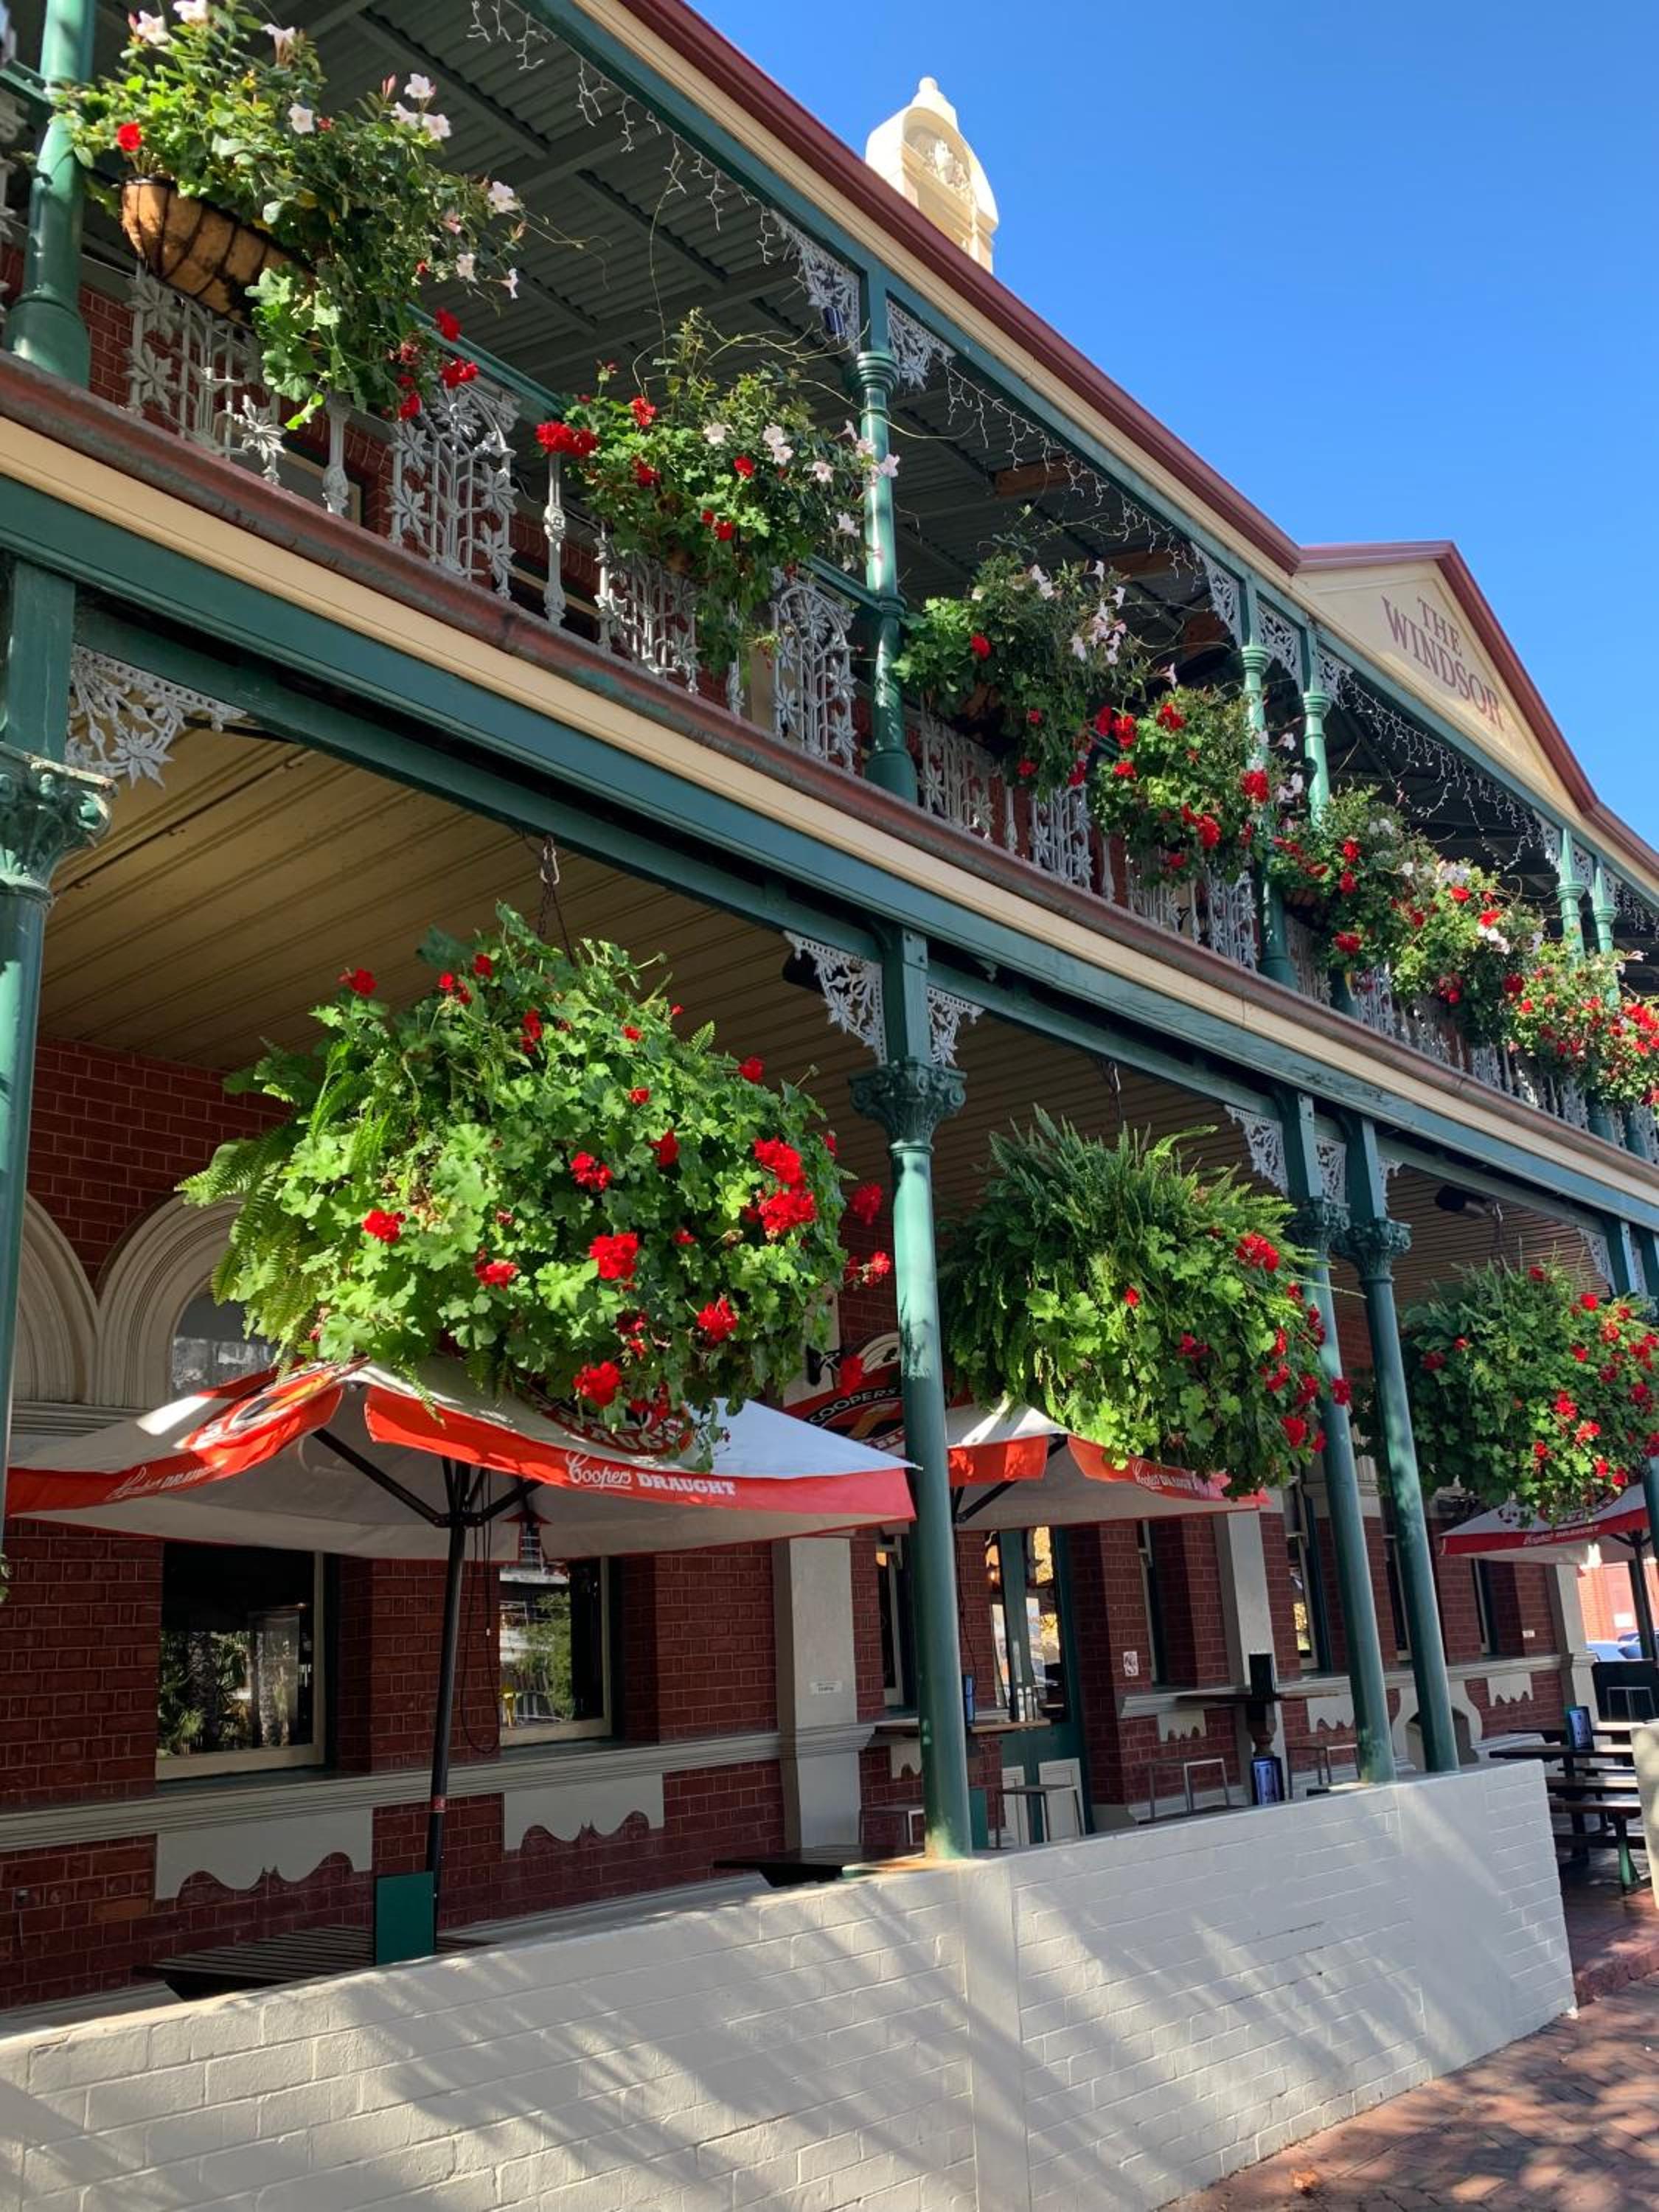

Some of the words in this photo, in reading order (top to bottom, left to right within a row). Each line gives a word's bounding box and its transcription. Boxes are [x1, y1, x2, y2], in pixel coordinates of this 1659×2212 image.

[1417, 597, 1462, 657] THE
[1381, 596, 1505, 731] WINDSOR
[810, 1387, 897, 1423] COOPERS
[566, 1450, 633, 1489] Coopers
[636, 1472, 736, 1495] DRAUGHT
